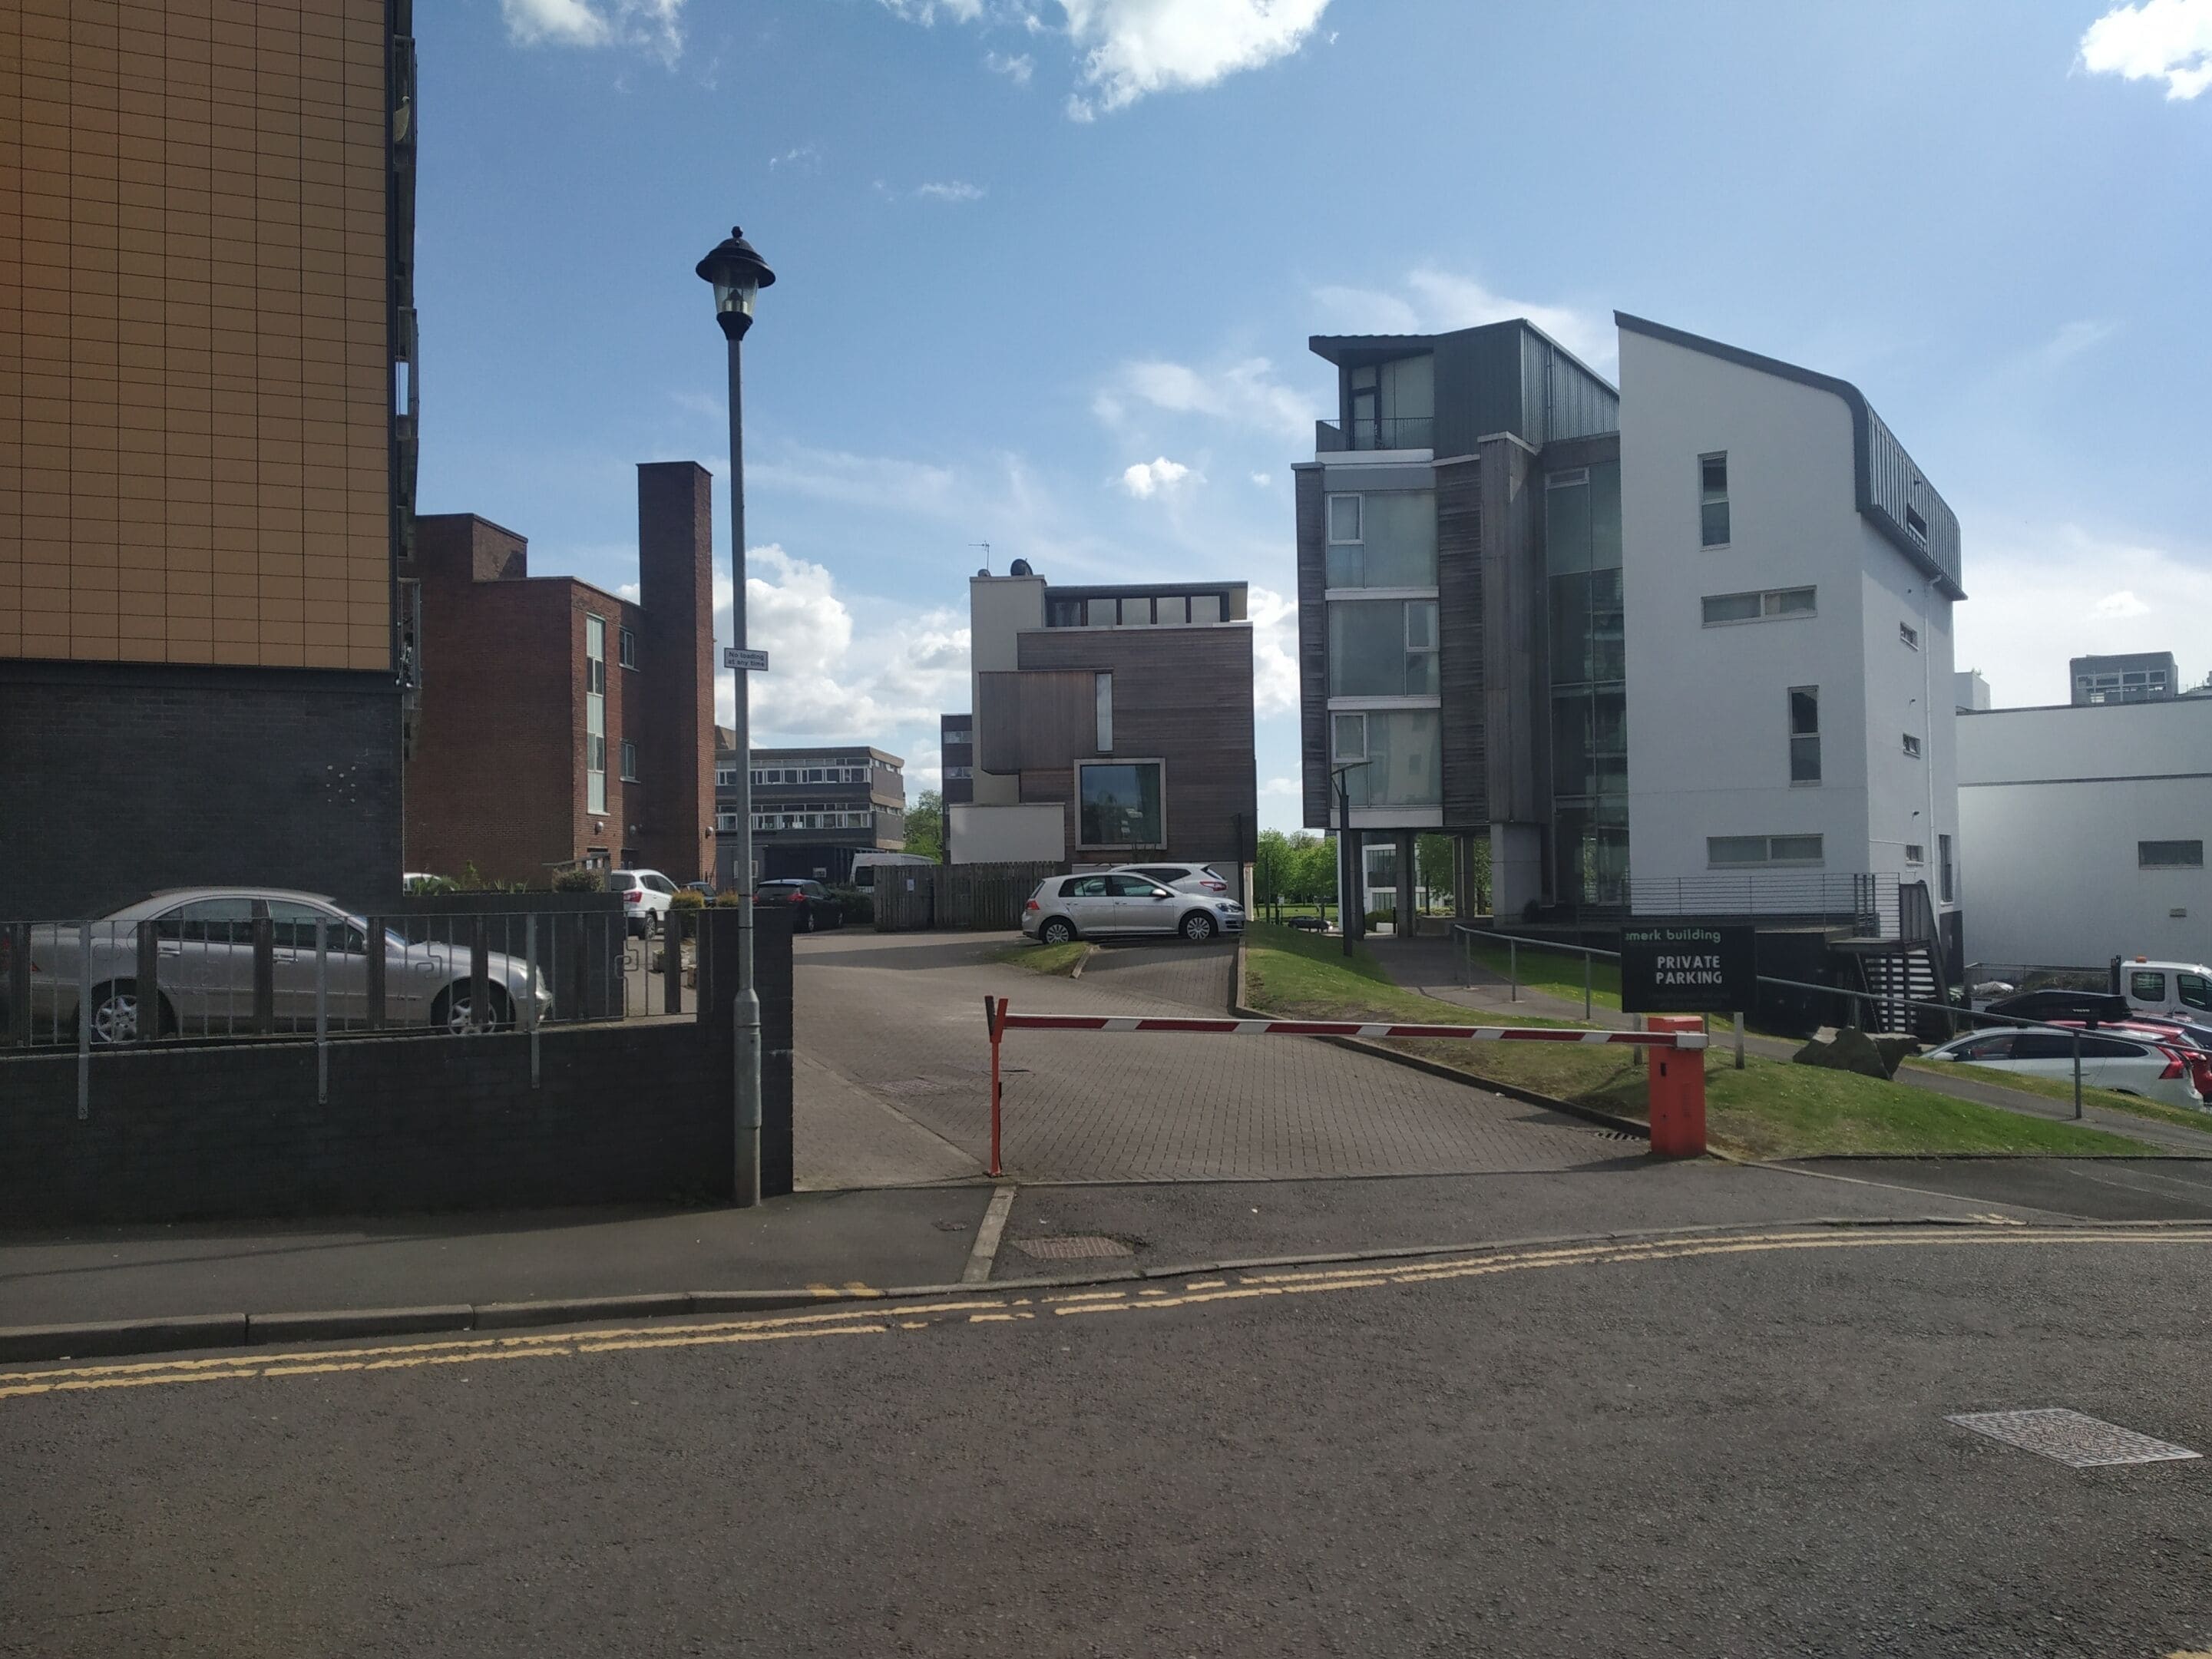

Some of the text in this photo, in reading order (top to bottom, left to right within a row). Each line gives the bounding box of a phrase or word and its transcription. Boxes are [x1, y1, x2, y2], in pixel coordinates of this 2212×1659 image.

[740, 653, 764, 661] loading
[1666, 929, 1721, 943] building
[1657, 955, 1721, 969] PRIVATE
[1655, 971, 1723, 984] PARKING
